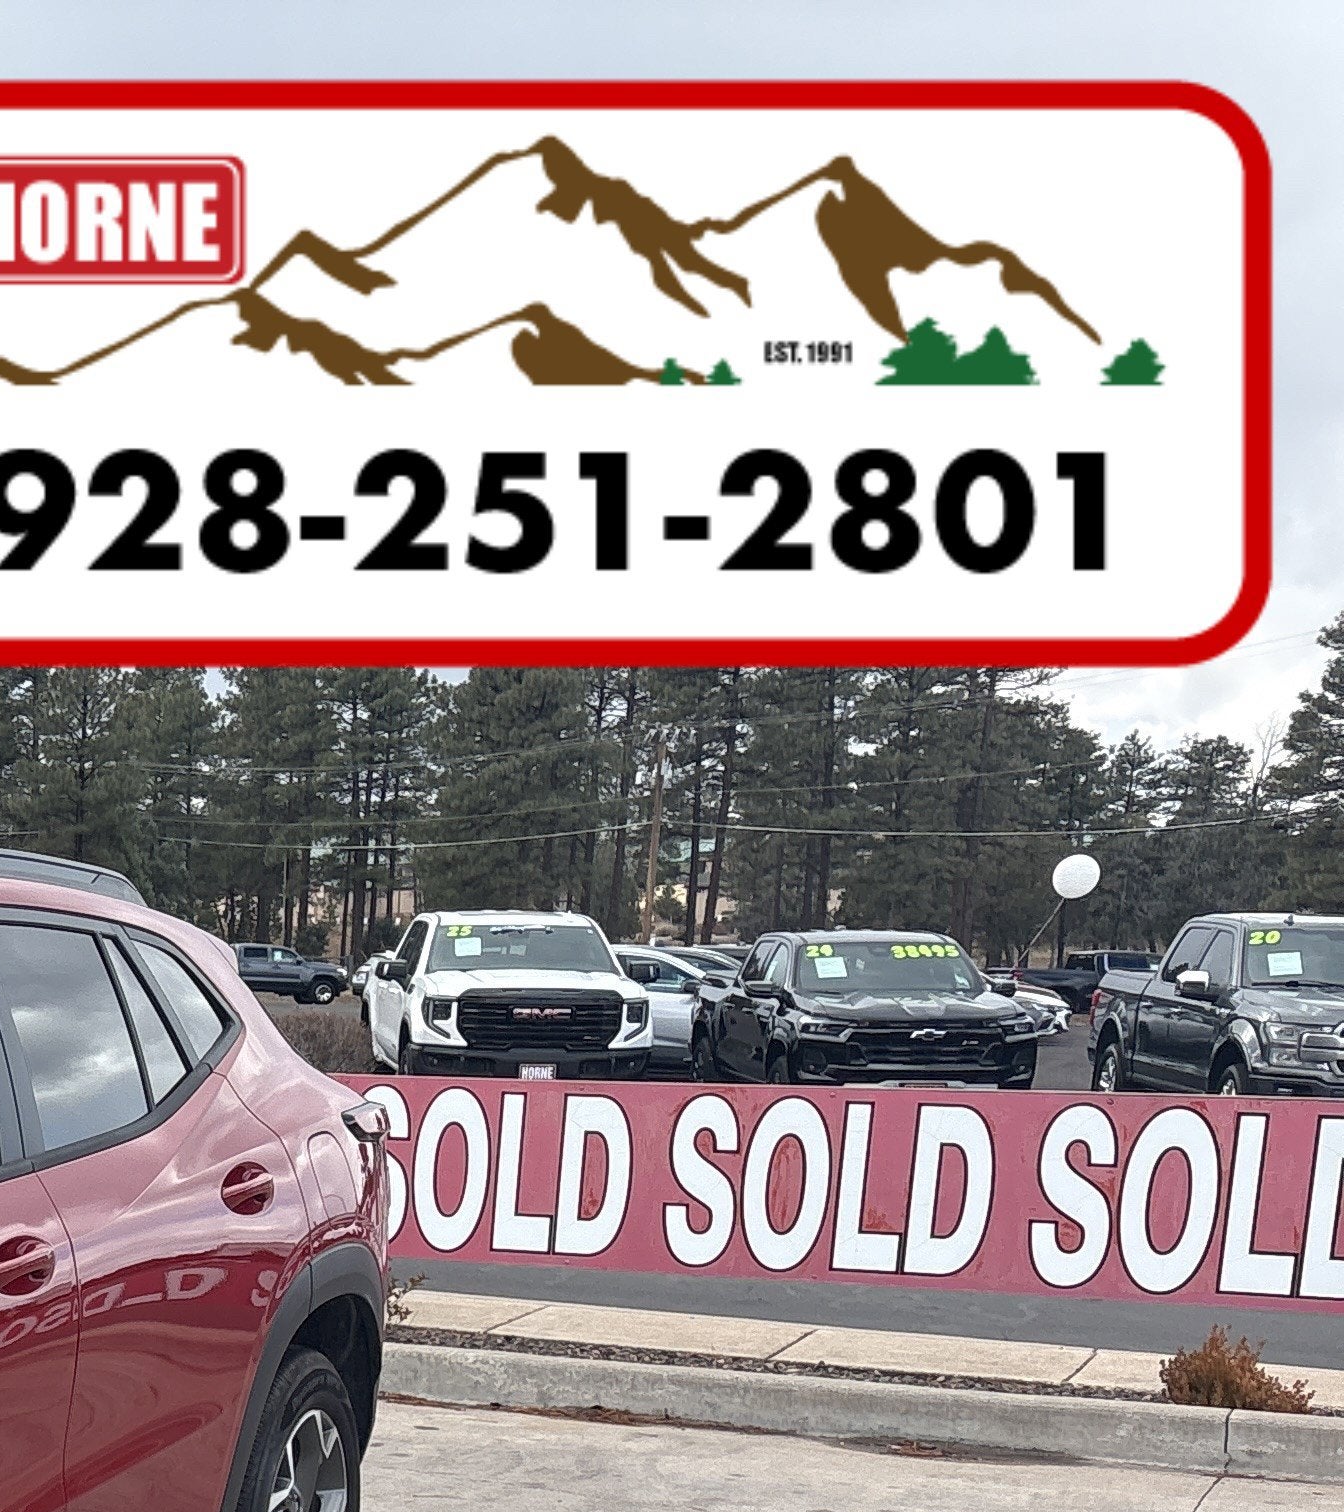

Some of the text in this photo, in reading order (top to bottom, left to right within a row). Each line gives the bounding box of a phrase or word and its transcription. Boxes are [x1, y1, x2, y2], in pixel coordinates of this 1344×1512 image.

[446, 924, 473, 937] 25
[1248, 930, 1282, 945] 20
[512, 1007, 572, 1019] GMC
[520, 1065, 555, 1080] HORNE
[662, 1093, 996, 1277] SOLD
